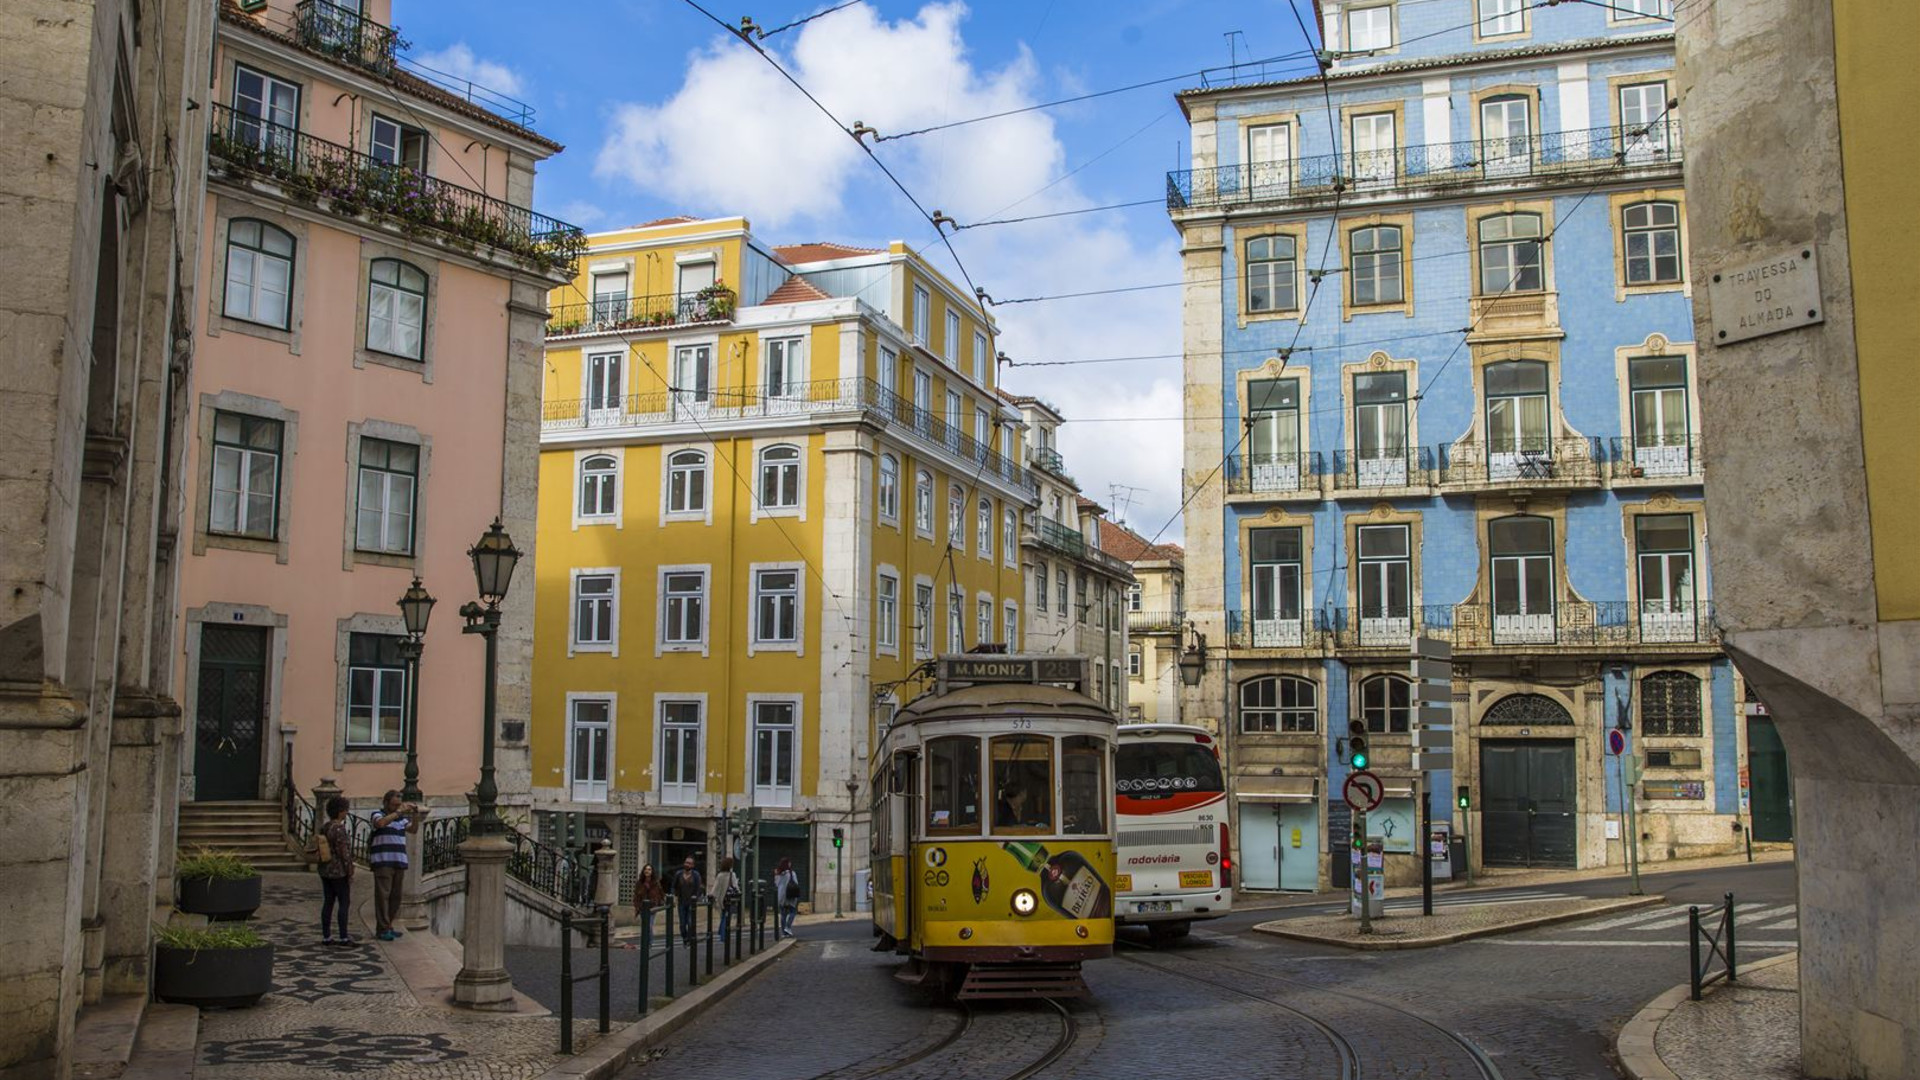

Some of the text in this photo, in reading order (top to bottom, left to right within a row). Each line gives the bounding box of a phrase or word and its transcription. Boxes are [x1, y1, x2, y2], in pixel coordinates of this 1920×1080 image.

[1729, 259, 1798, 287] TRAVESSA
[1754, 288, 1772, 303] DO
[1739, 305, 1794, 329] ALMADA
[1045, 662, 1071, 677] 28
[1012, 719, 1032, 729] 573
